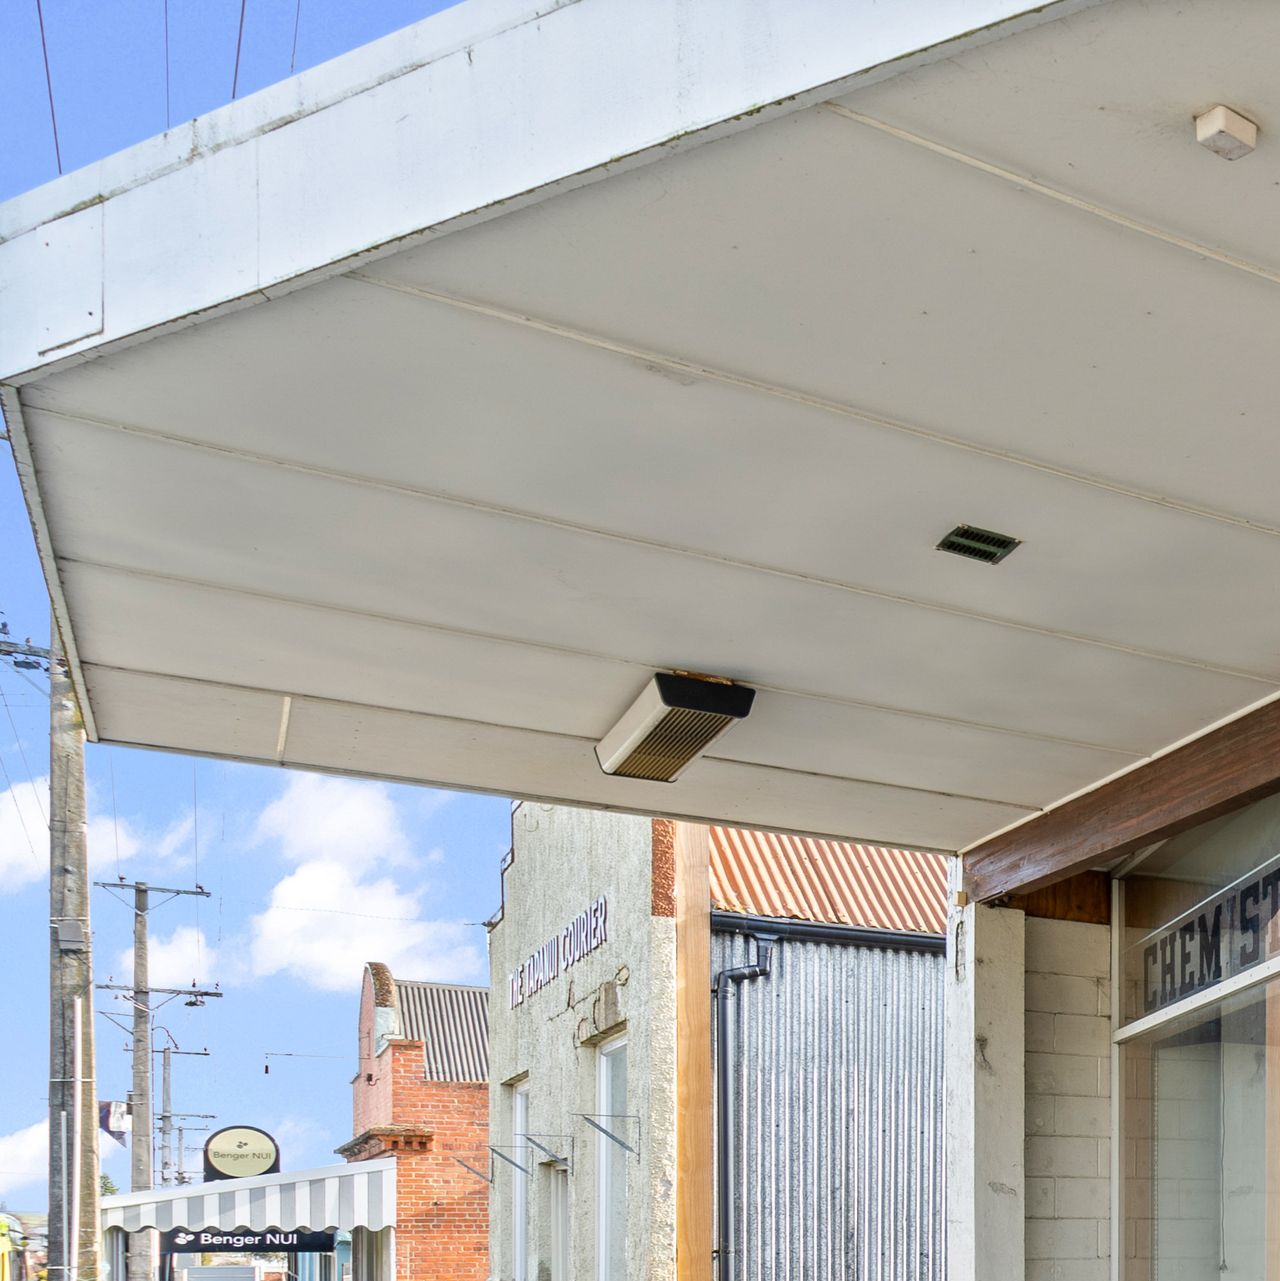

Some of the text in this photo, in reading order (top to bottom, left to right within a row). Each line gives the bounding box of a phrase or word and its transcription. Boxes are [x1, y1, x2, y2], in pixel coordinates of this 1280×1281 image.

[508, 895, 607, 1010] THE TAPANUI COURIER
[213, 1151, 272, 1161] Benger NUI
[201, 1233, 297, 1247] Benger NUI
